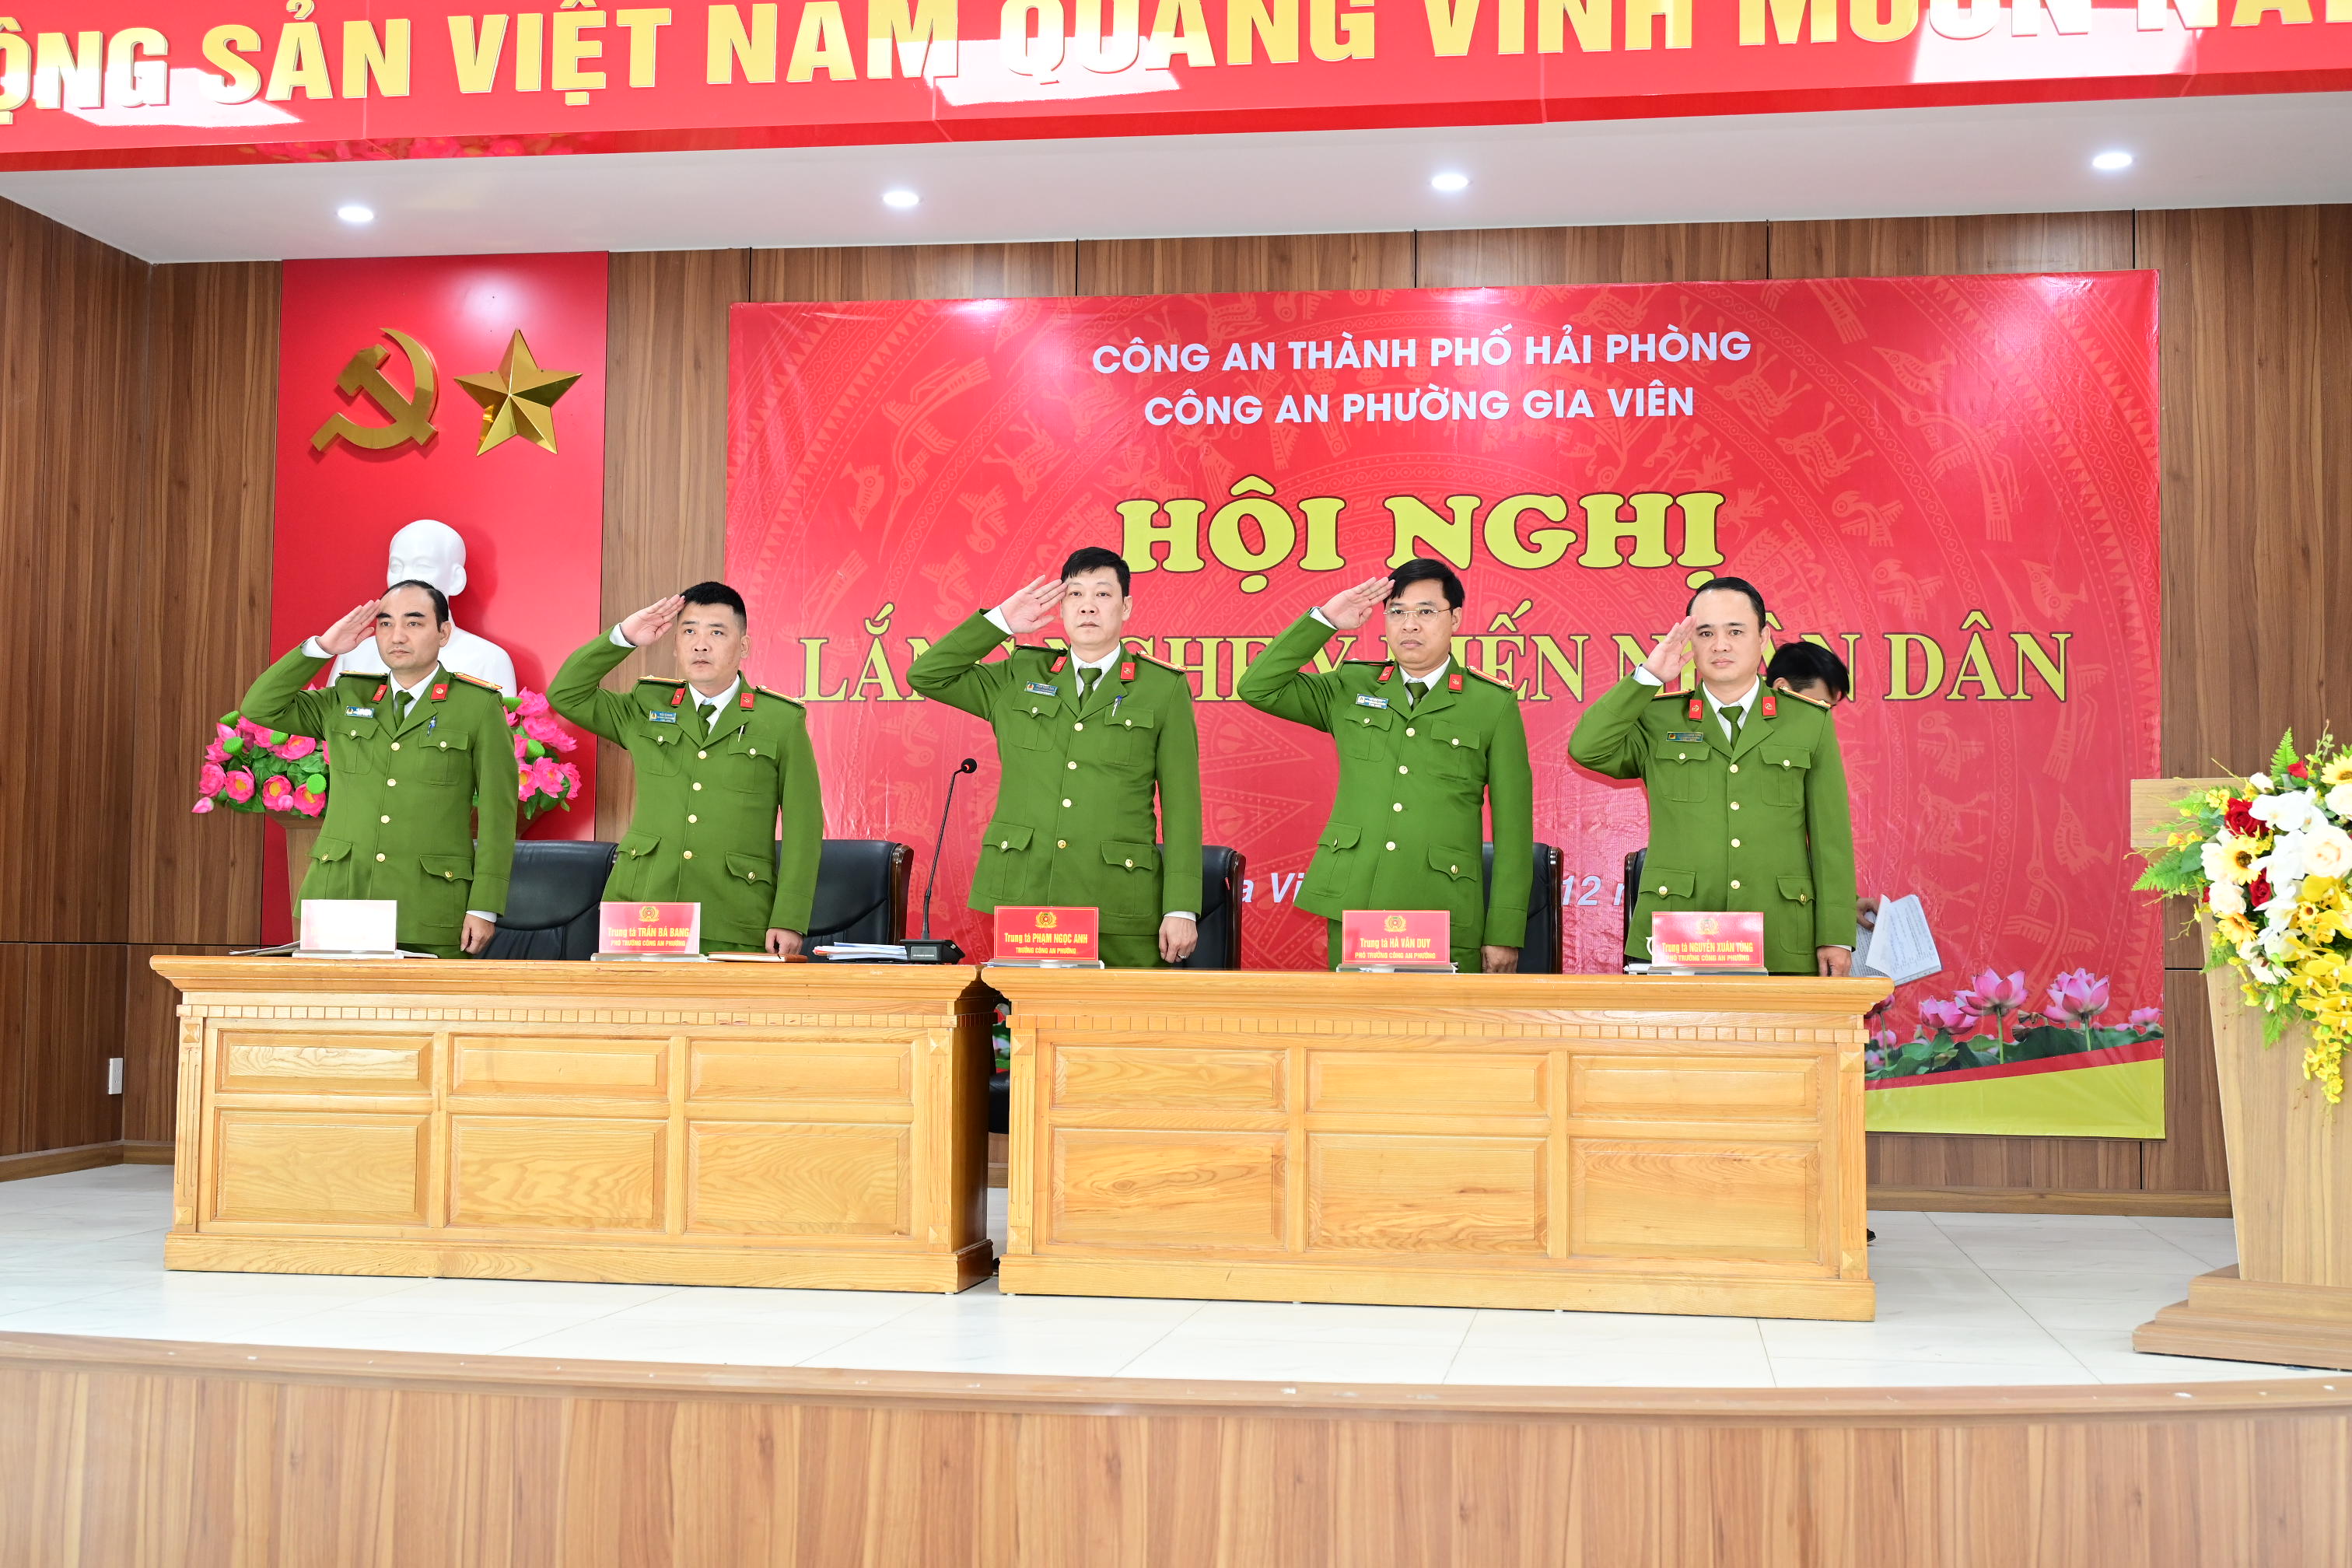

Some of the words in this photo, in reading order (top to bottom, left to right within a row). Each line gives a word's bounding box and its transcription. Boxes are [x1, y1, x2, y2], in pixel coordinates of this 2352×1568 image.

[201, 0, 411, 105] SẢN
[446, 0, 672, 106] VIỆT
[706, 0, 960, 84] NAM
[999, 0, 1376, 86] QUANG
[1425, 0, 1692, 58] VINH
[1092, 336, 1210, 373] CÔNG
[1221, 341, 1275, 371] AN
[1288, 331, 1416, 369] THÀNH
[1430, 323, 1513, 366] PHỐ
[1525, 324, 1591, 364] HẢI
[1606, 324, 1752, 362] PHÒNG
[1144, 388, 1263, 425] CÔNG
[1274, 394, 1328, 423] AN
[1343, 383, 1510, 422] PHƯỜNG
[1523, 389, 1594, 418] GIA
[1607, 379, 1693, 417] VIÊN
[1114, 474, 1347, 594] HỘI
[1382, 492, 1726, 590] NGHỊ
[1882, 609, 2074, 702] DÂN
[1562, 875, 1601, 906] 12
[608, 926, 628, 938] Trung
[629, 927, 636, 937] tá
[658, 926, 668, 937] BÁ
[670, 927, 690, 937] BANG
[1004, 933, 1023, 944] Trung
[1024, 933, 1031, 943] tá
[1032, 933, 1052, 945] PHẠM
[1053, 933, 1073, 946] NGỌC
[1073, 933, 1088, 944] ANH
[1360, 937, 1380, 949] Trung
[1389, 936, 1399, 948] HÀ
[1401, 936, 1416, 948] VĂN
[1416, 938, 1431, 948] DUY
[1661, 942, 1680, 954] Trung
[1682, 942, 1688, 953] tá
[1689, 939, 1716, 953] NGUYỄN
[1717, 940, 1735, 953] XUÂN
[1355, 950, 1367, 959] PHÓ
